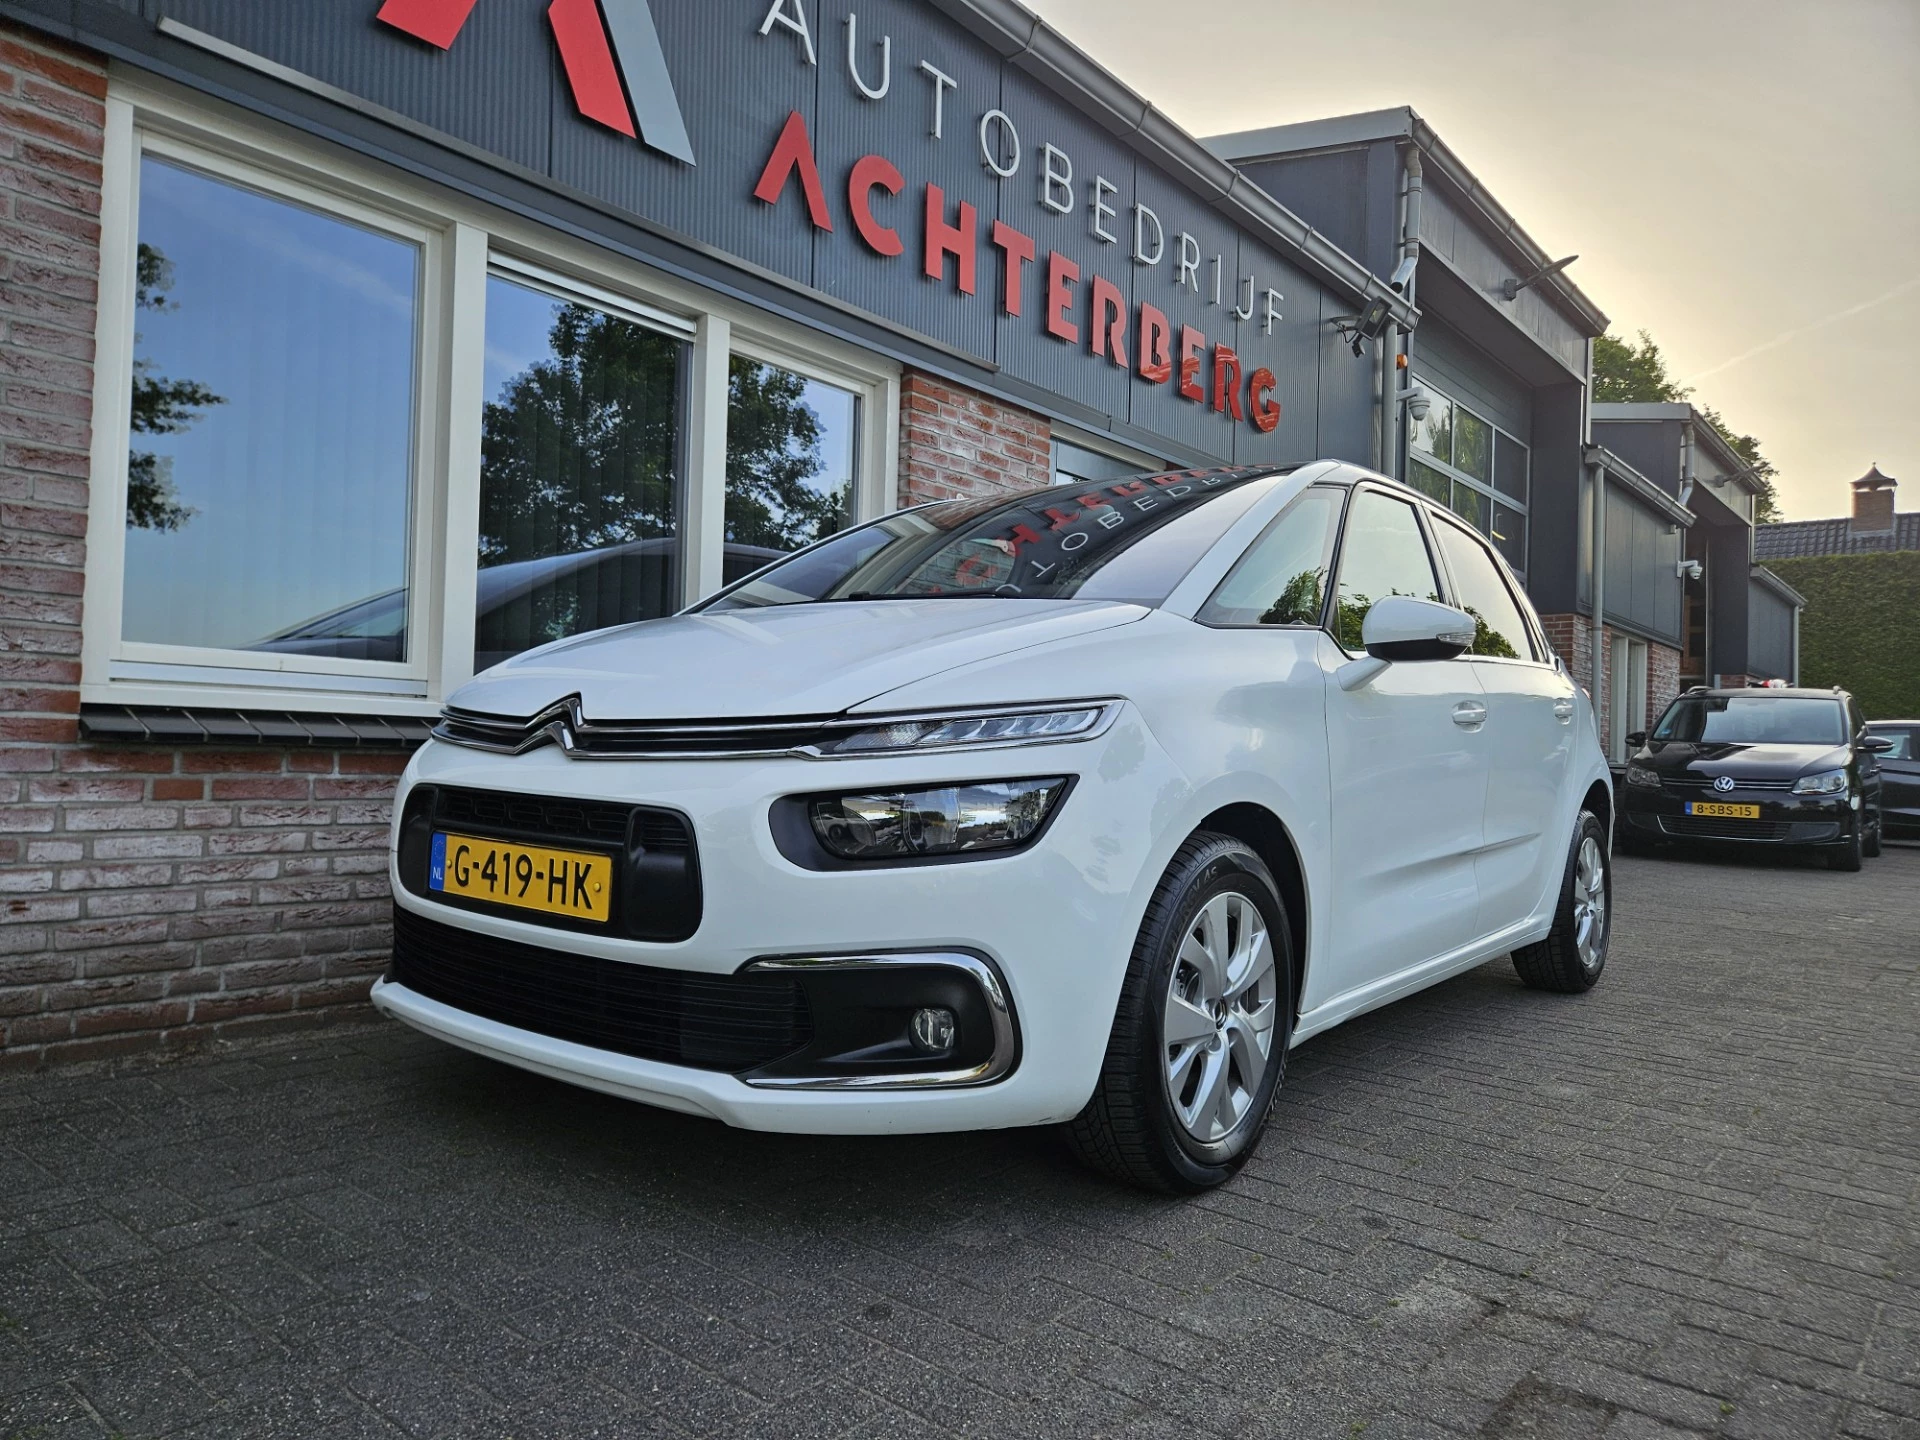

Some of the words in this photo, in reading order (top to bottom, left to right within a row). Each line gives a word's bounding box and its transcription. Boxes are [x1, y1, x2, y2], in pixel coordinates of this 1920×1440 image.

[758, 0, 1285, 337] AUTOBEDRIJF
[753, 110, 1282, 434] ACHTERBERG
[1697, 804, 1751, 816] 8-SBS-15
[432, 866, 443, 881] NL
[454, 845, 593, 910] G-419-HK
